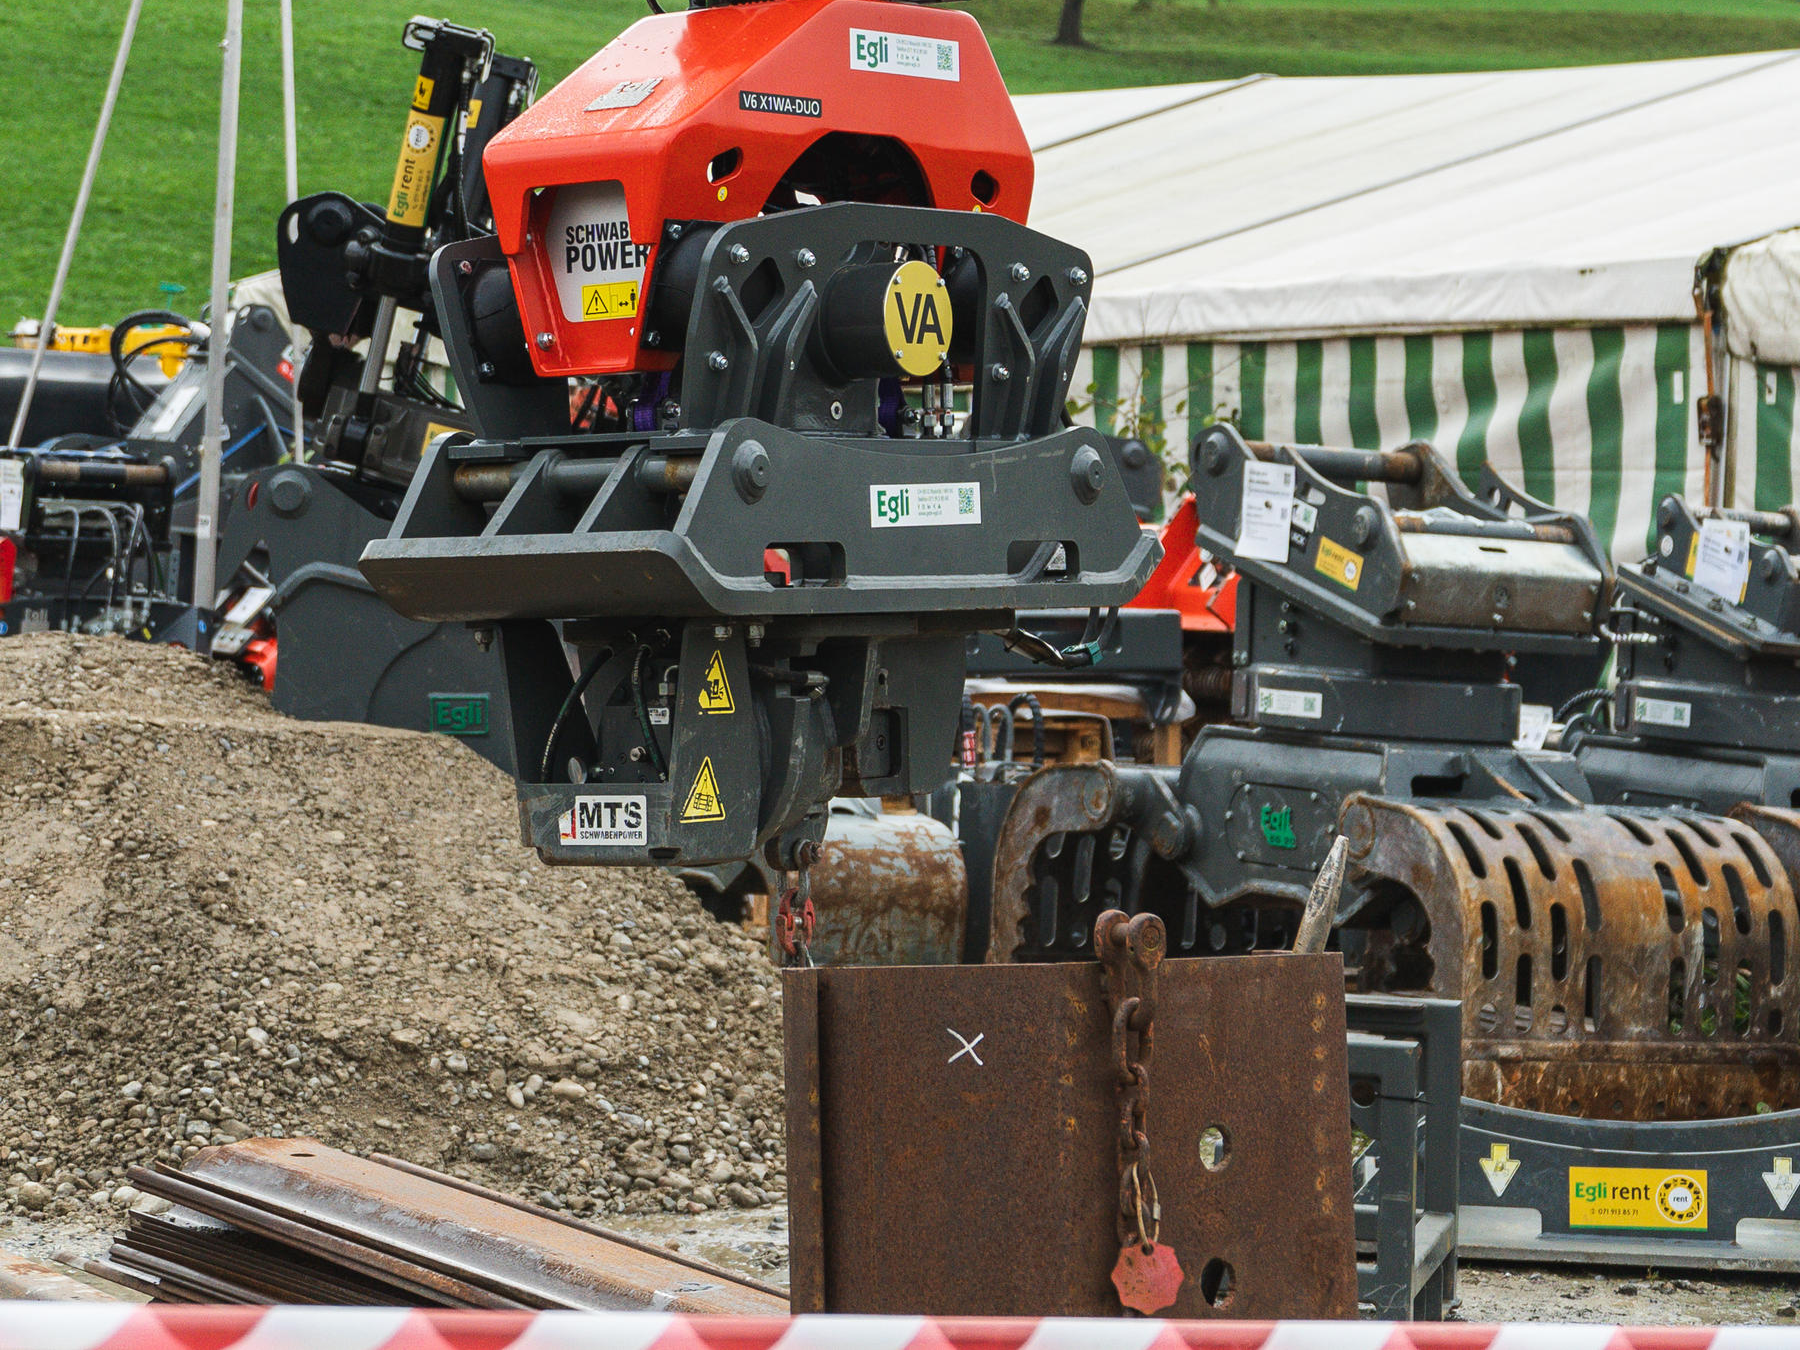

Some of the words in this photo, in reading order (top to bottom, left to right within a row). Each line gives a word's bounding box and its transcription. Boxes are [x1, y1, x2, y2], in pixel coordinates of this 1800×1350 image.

[856, 34, 889, 68] Egli
[742, 92, 758, 109] V6
[759, 95, 821, 116] X1WA-DUO
[401, 157, 417, 190] rent
[393, 190, 410, 218] Egli
[894, 291, 945, 346] VA
[876, 487, 910, 524] Egli
[436, 701, 482, 730] Egli
[579, 801, 643, 829] MTS
[1261, 805, 1292, 831] Egli
[579, 830, 643, 840] SCHWABENPOWER
[1575, 1182, 1608, 1203] Egli
[1611, 1184, 1651, 1201] rent
[1672, 1194, 1689, 1203] rent
[1597, 1208, 1609, 1216] 071
